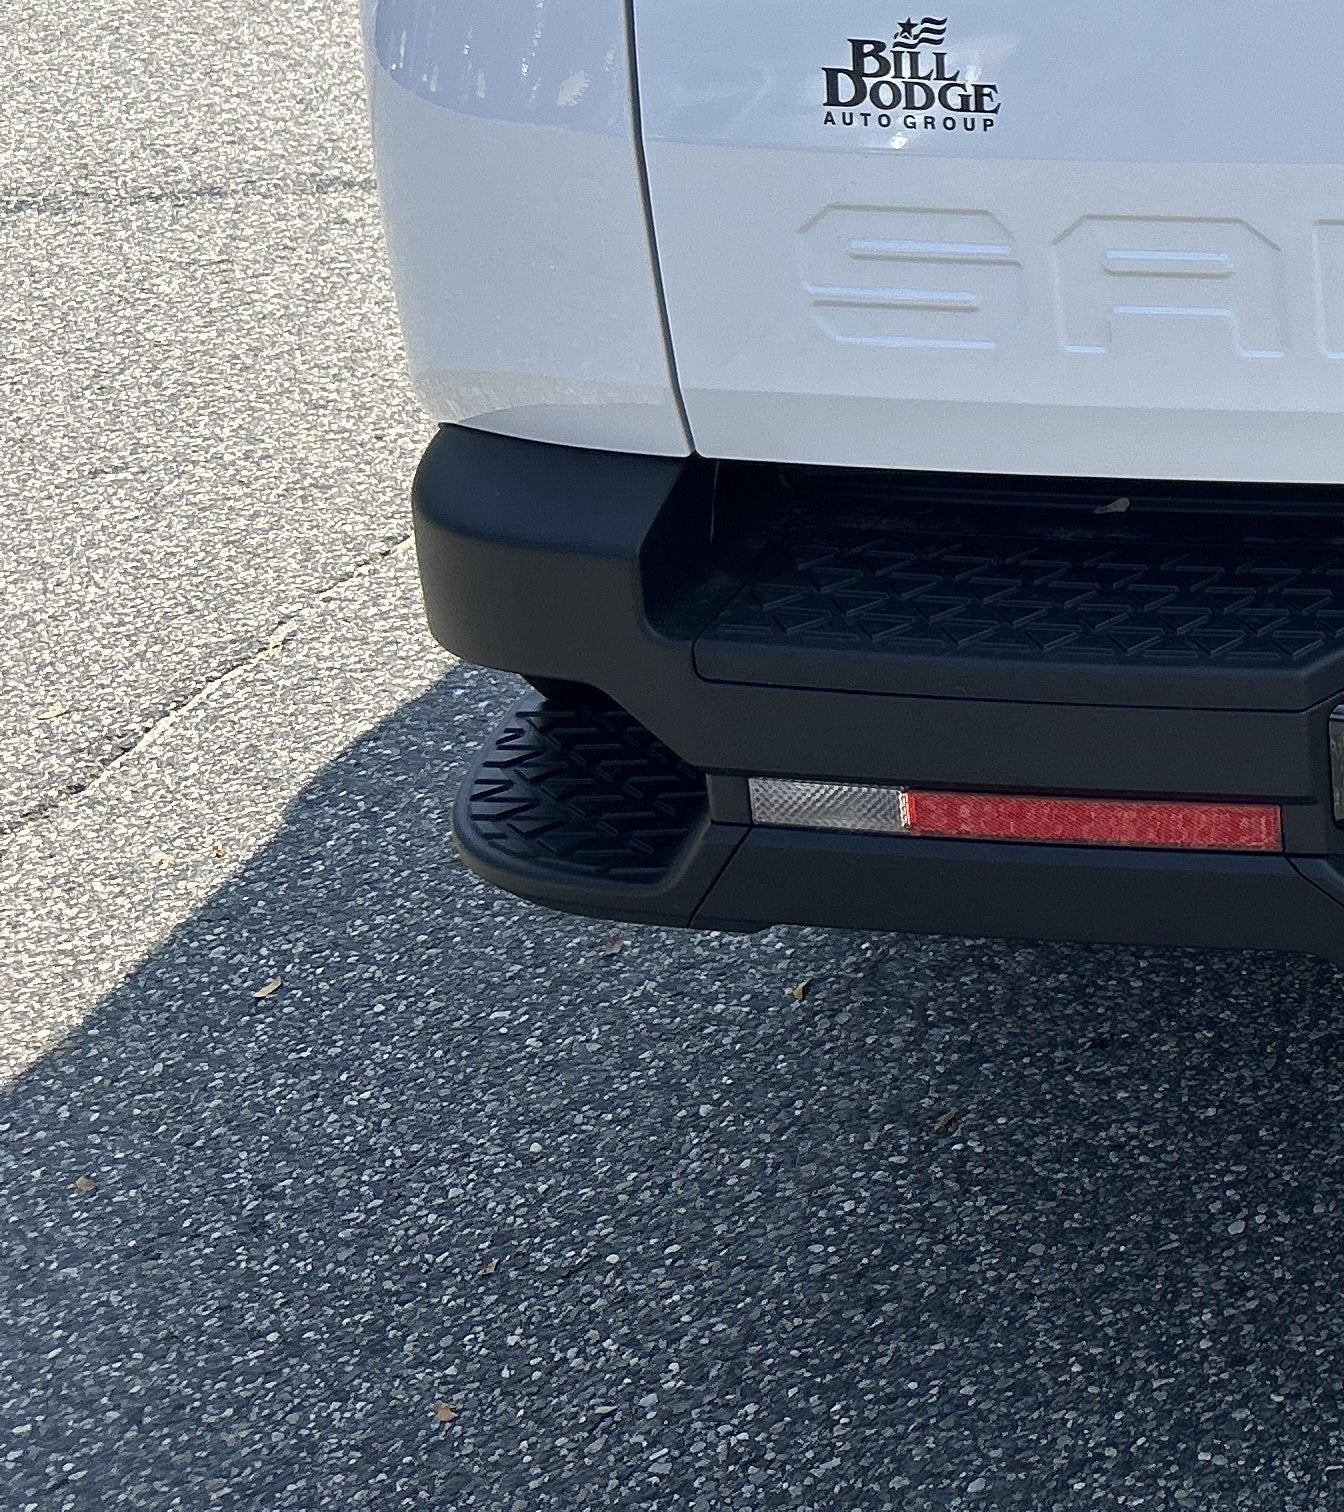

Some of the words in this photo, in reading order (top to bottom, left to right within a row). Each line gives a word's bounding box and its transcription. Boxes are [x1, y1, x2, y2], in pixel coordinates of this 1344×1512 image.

[847, 38, 960, 82] BILL
[821, 67, 1001, 115] DODGE
[823, 111, 892, 128] AUTO
[903, 114, 995, 132] GROUP
